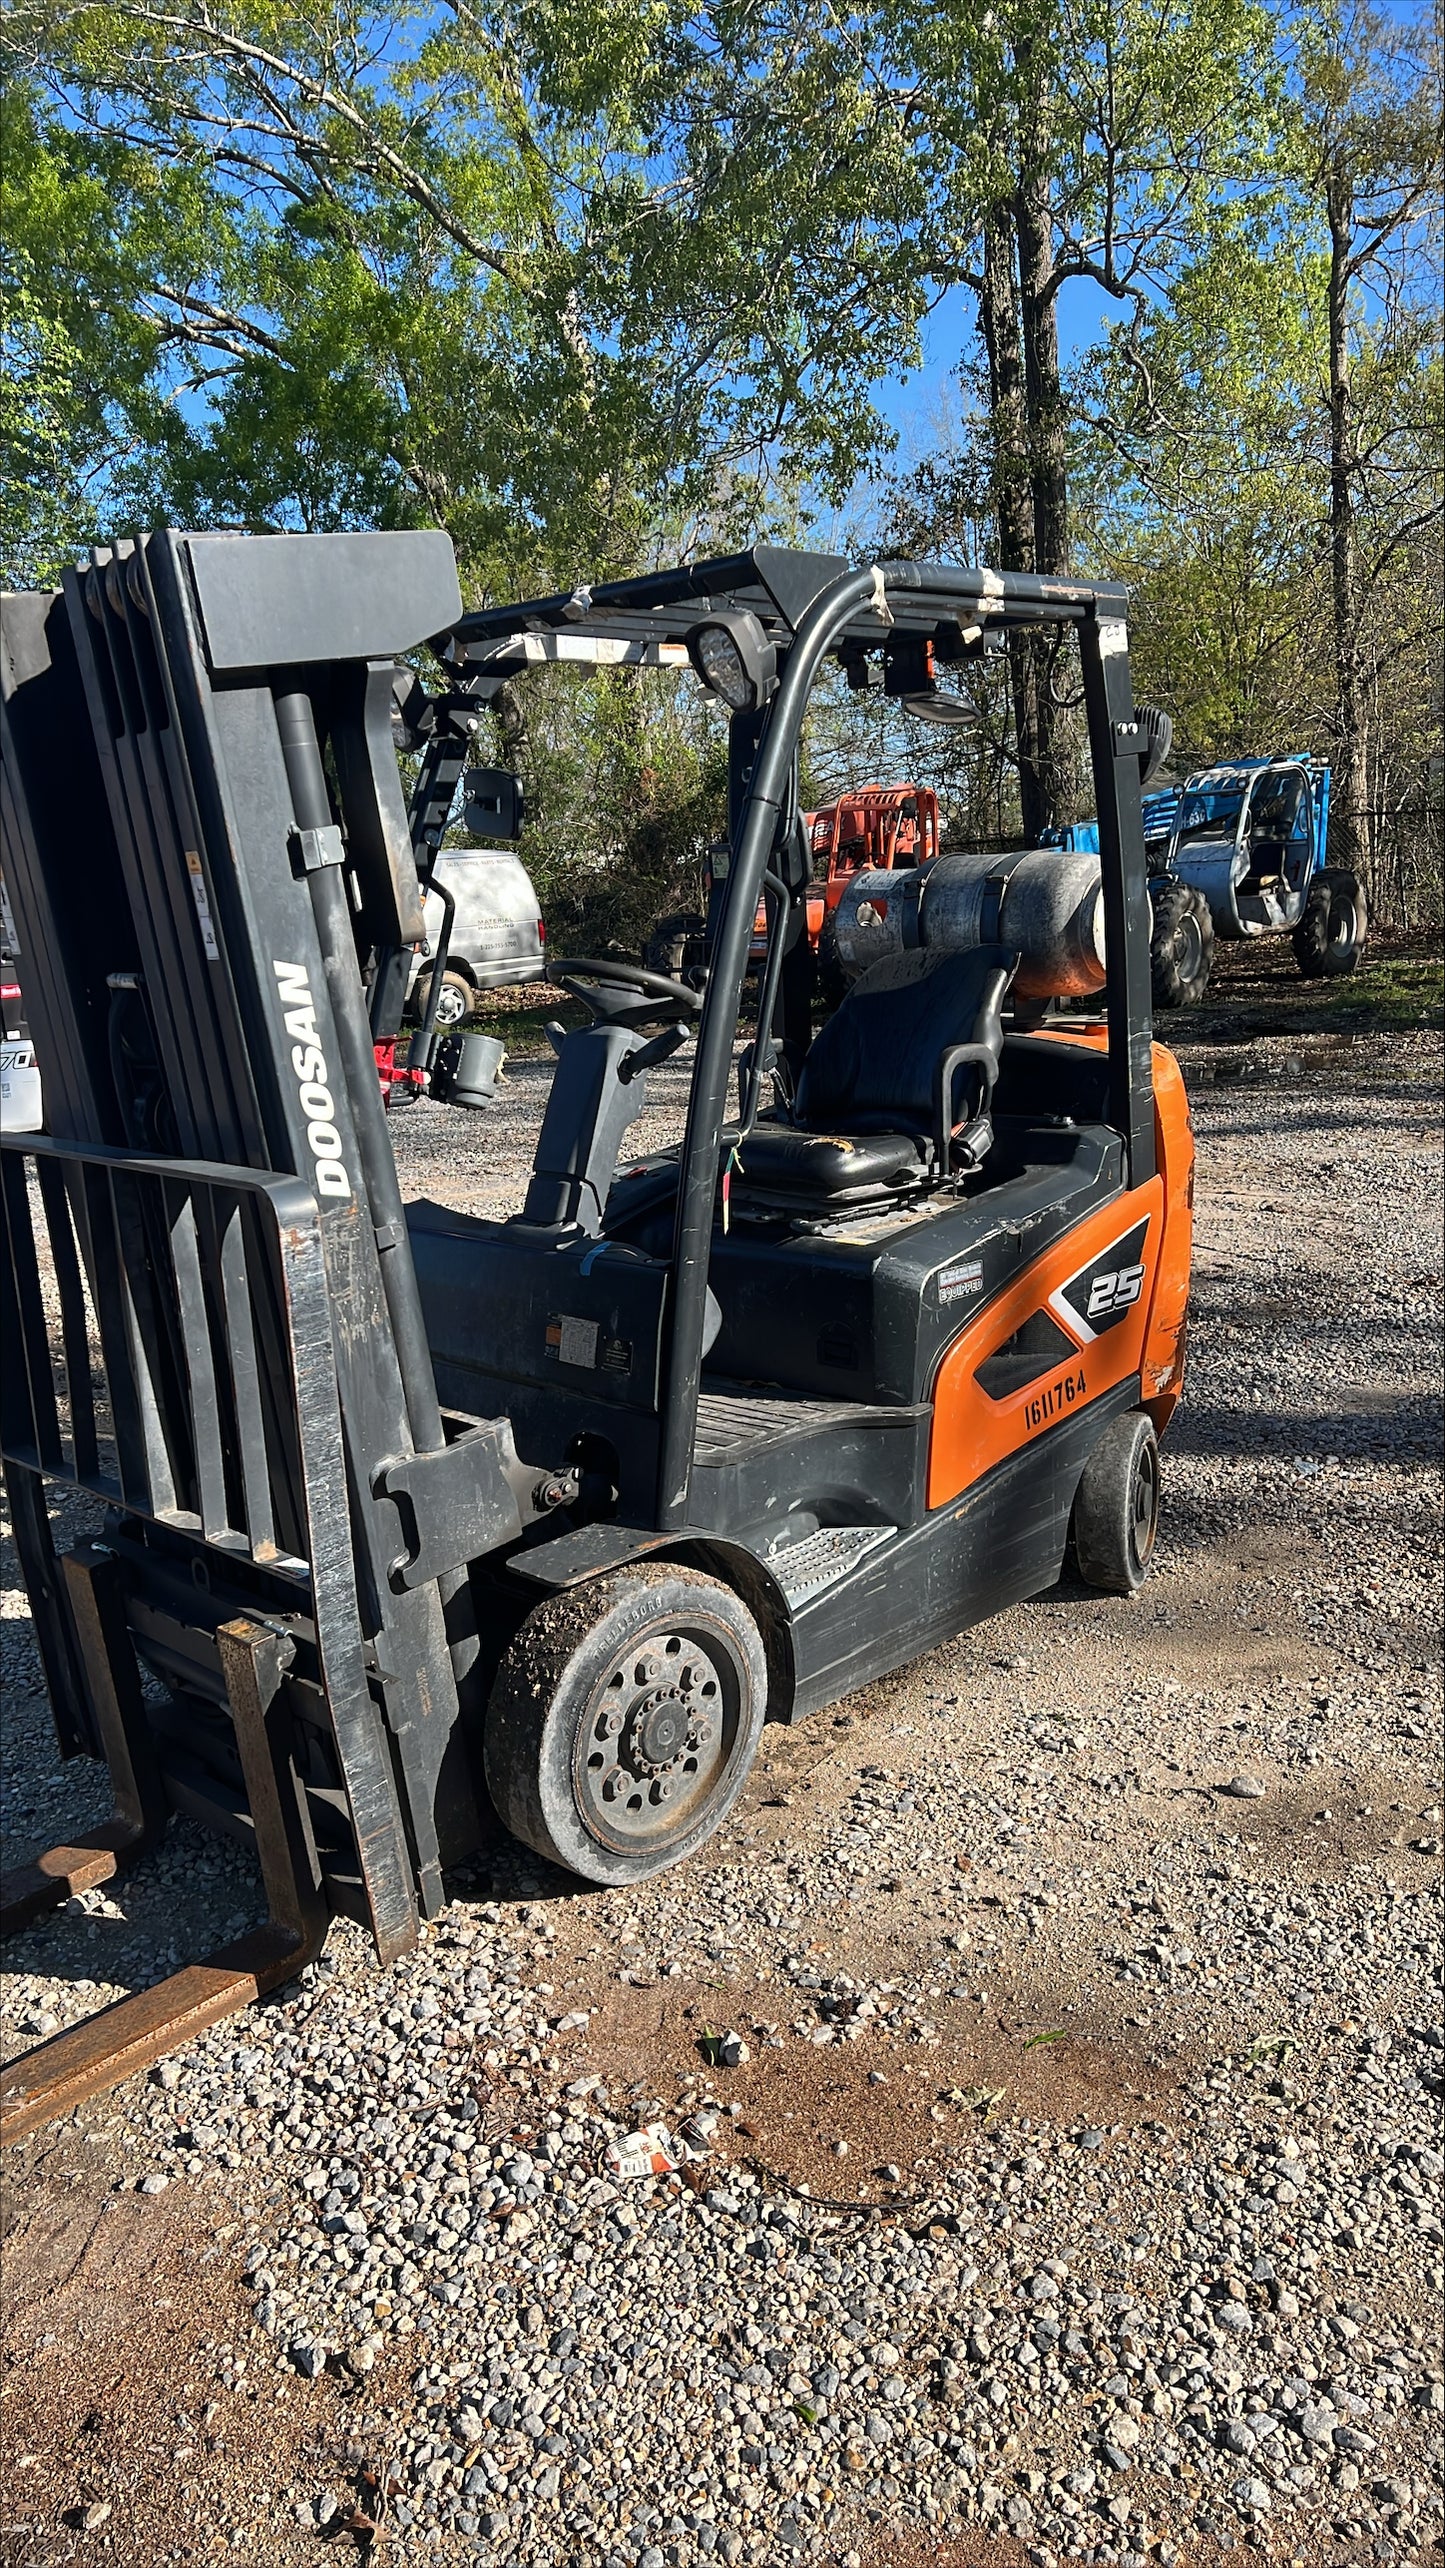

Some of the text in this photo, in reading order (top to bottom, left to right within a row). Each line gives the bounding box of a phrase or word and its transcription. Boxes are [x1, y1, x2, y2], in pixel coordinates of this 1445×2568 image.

[477, 917, 512, 926] MATERIAL
[273, 960, 351, 1197] DOOSAN
[939, 1278, 983, 1301] EQUIPPED
[1087, 1264, 1146, 1318] 25
[1024, 1369, 1087, 1431] 1611764
